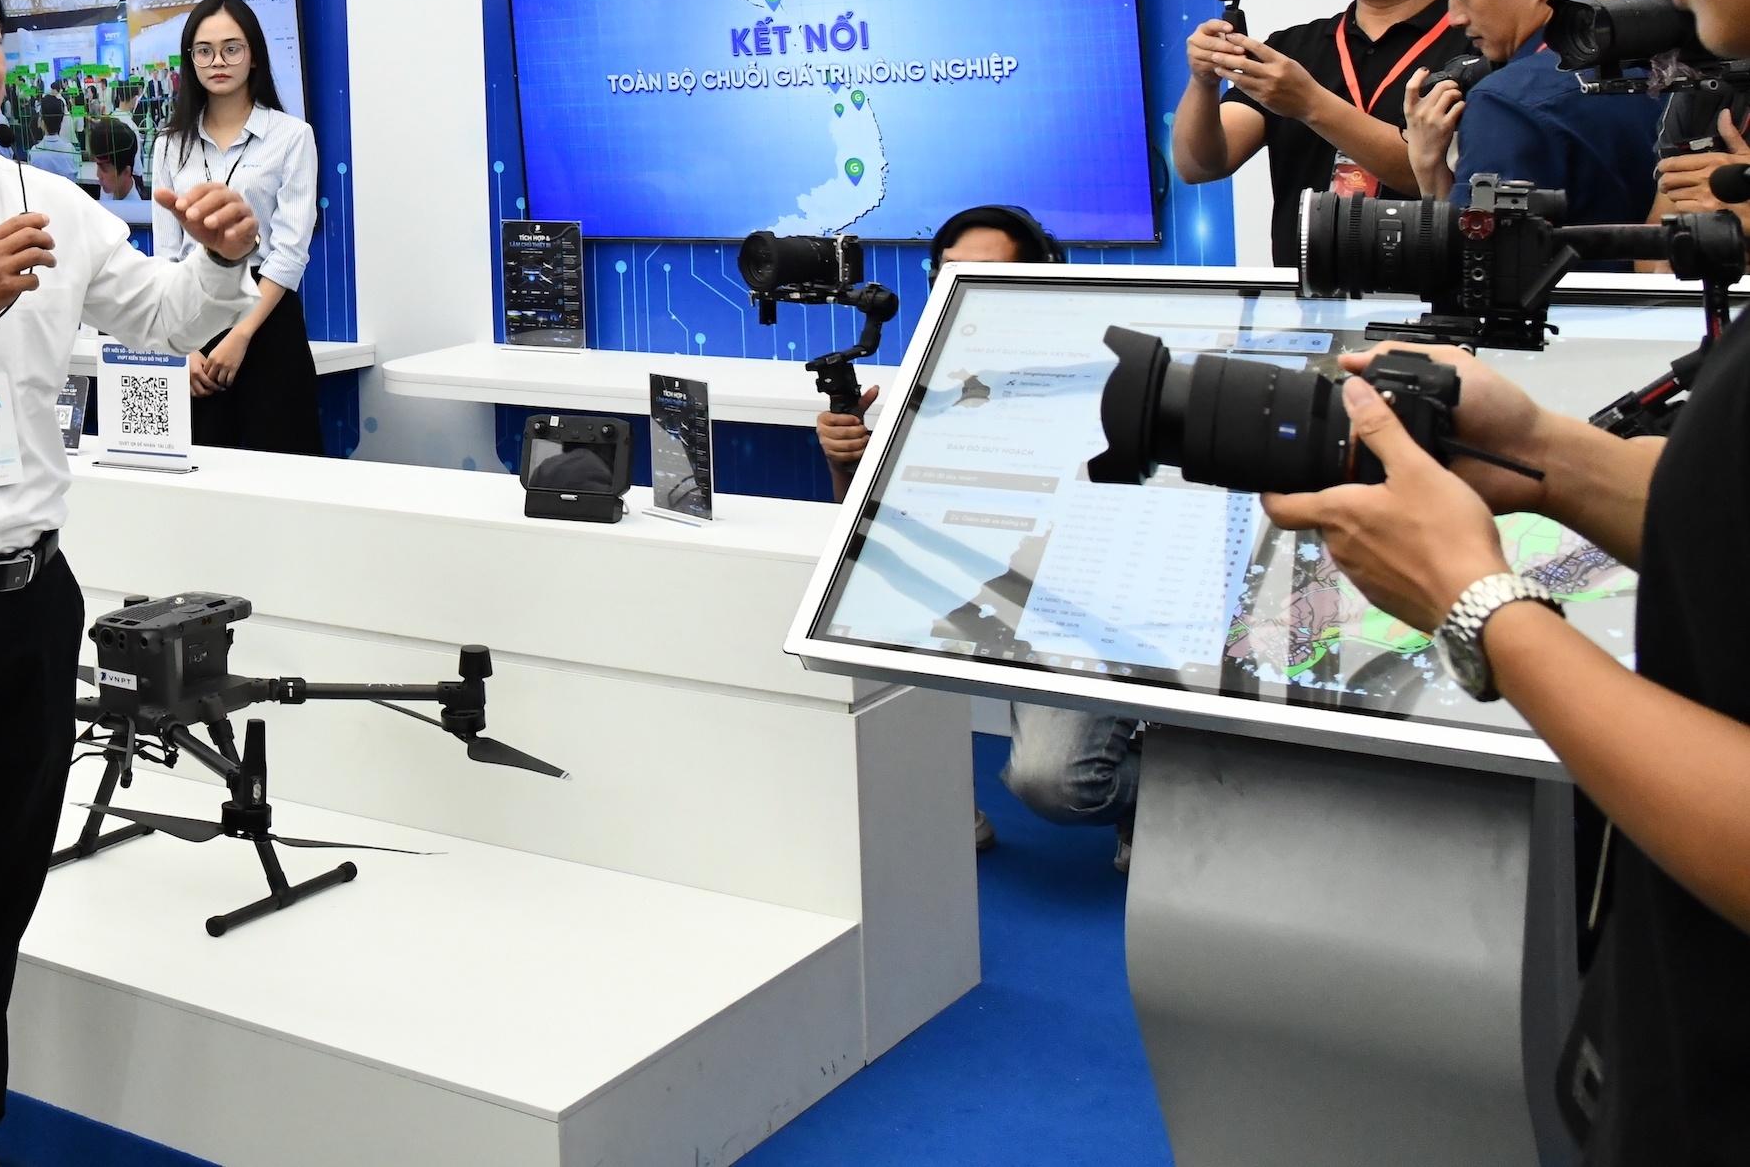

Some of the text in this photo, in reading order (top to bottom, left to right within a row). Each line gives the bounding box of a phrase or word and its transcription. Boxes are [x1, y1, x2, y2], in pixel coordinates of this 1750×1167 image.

[730, 11, 870, 57] KẾT NỐI
[607, 51, 1019, 95] TOÀN BỘ CHUỖI GIÁ TRỊ NÔNG NGHIỆP
[109, 676, 131, 685] VNPT
